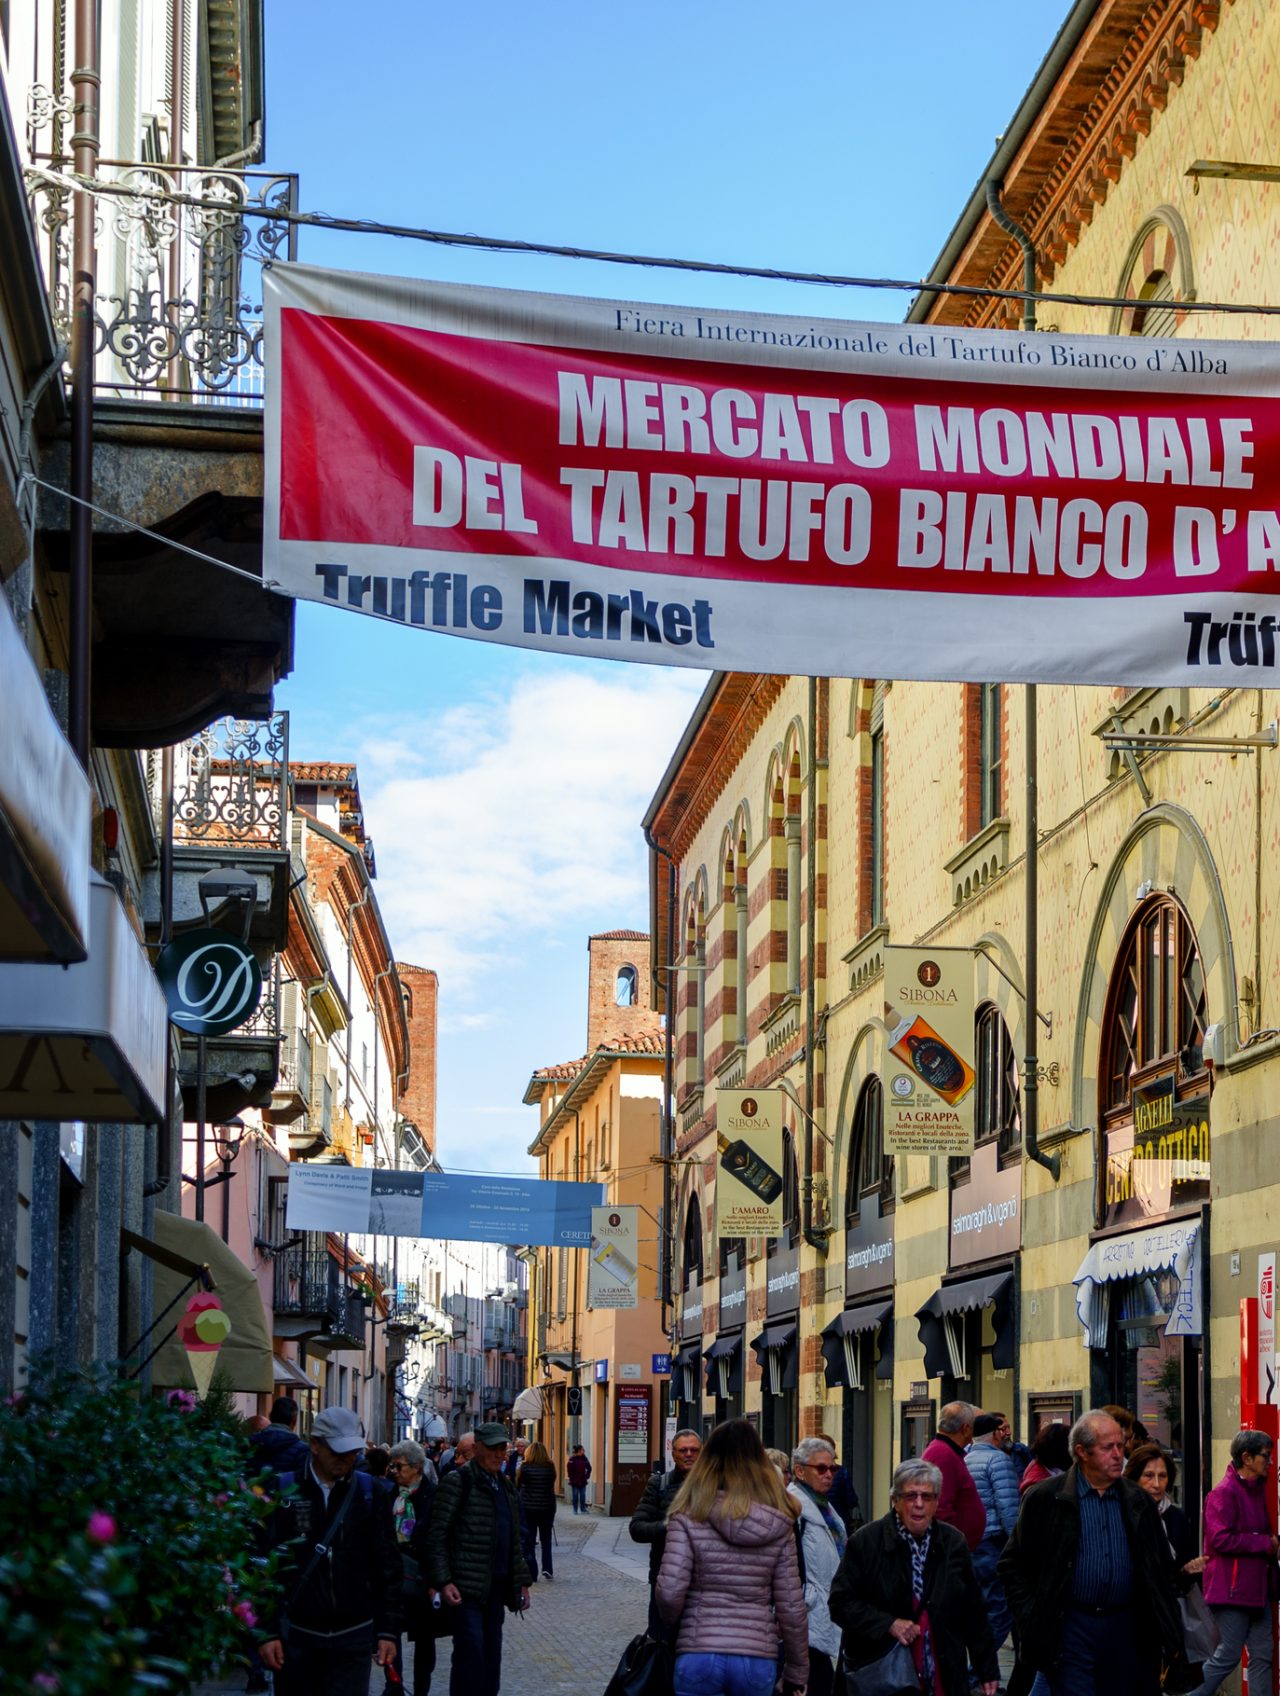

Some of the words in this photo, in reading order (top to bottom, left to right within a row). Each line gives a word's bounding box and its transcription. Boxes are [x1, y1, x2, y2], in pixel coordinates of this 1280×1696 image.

[614, 309, 686, 338] Fiera
[697, 317, 889, 355] Internazionale
[897, 333, 938, 360] del
[943, 336, 1041, 367] Tartufo
[1050, 344, 1137, 371] Bianco
[1146, 349, 1229, 376] d’Alba
[557, 371, 891, 469] MERCATO
[913, 404, 1254, 490] MONDIALE
[412, 445, 539, 535] DEL
[559, 467, 873, 566] TARTUFO
[897, 488, 1149, 580] BIANCO
[316, 563, 503, 631] Truffle
[523, 579, 715, 649] Market
[172, 942, 255, 1023] D
[899, 987, 958, 1002] SIBONA
[728, 1117, 771, 1129] SIBONA
[898, 1111, 912, 1122] LA
[915, 1111, 960, 1123] GRAPPA
[913, 1123, 935, 1131] migliori
[1134, 1094, 1173, 1135] AGNELLI
[295, 1170, 310, 1178] Lynn
[1105, 1140, 1154, 1206] CENTRO
[1157, 1120, 1209, 1192] OTTICO
